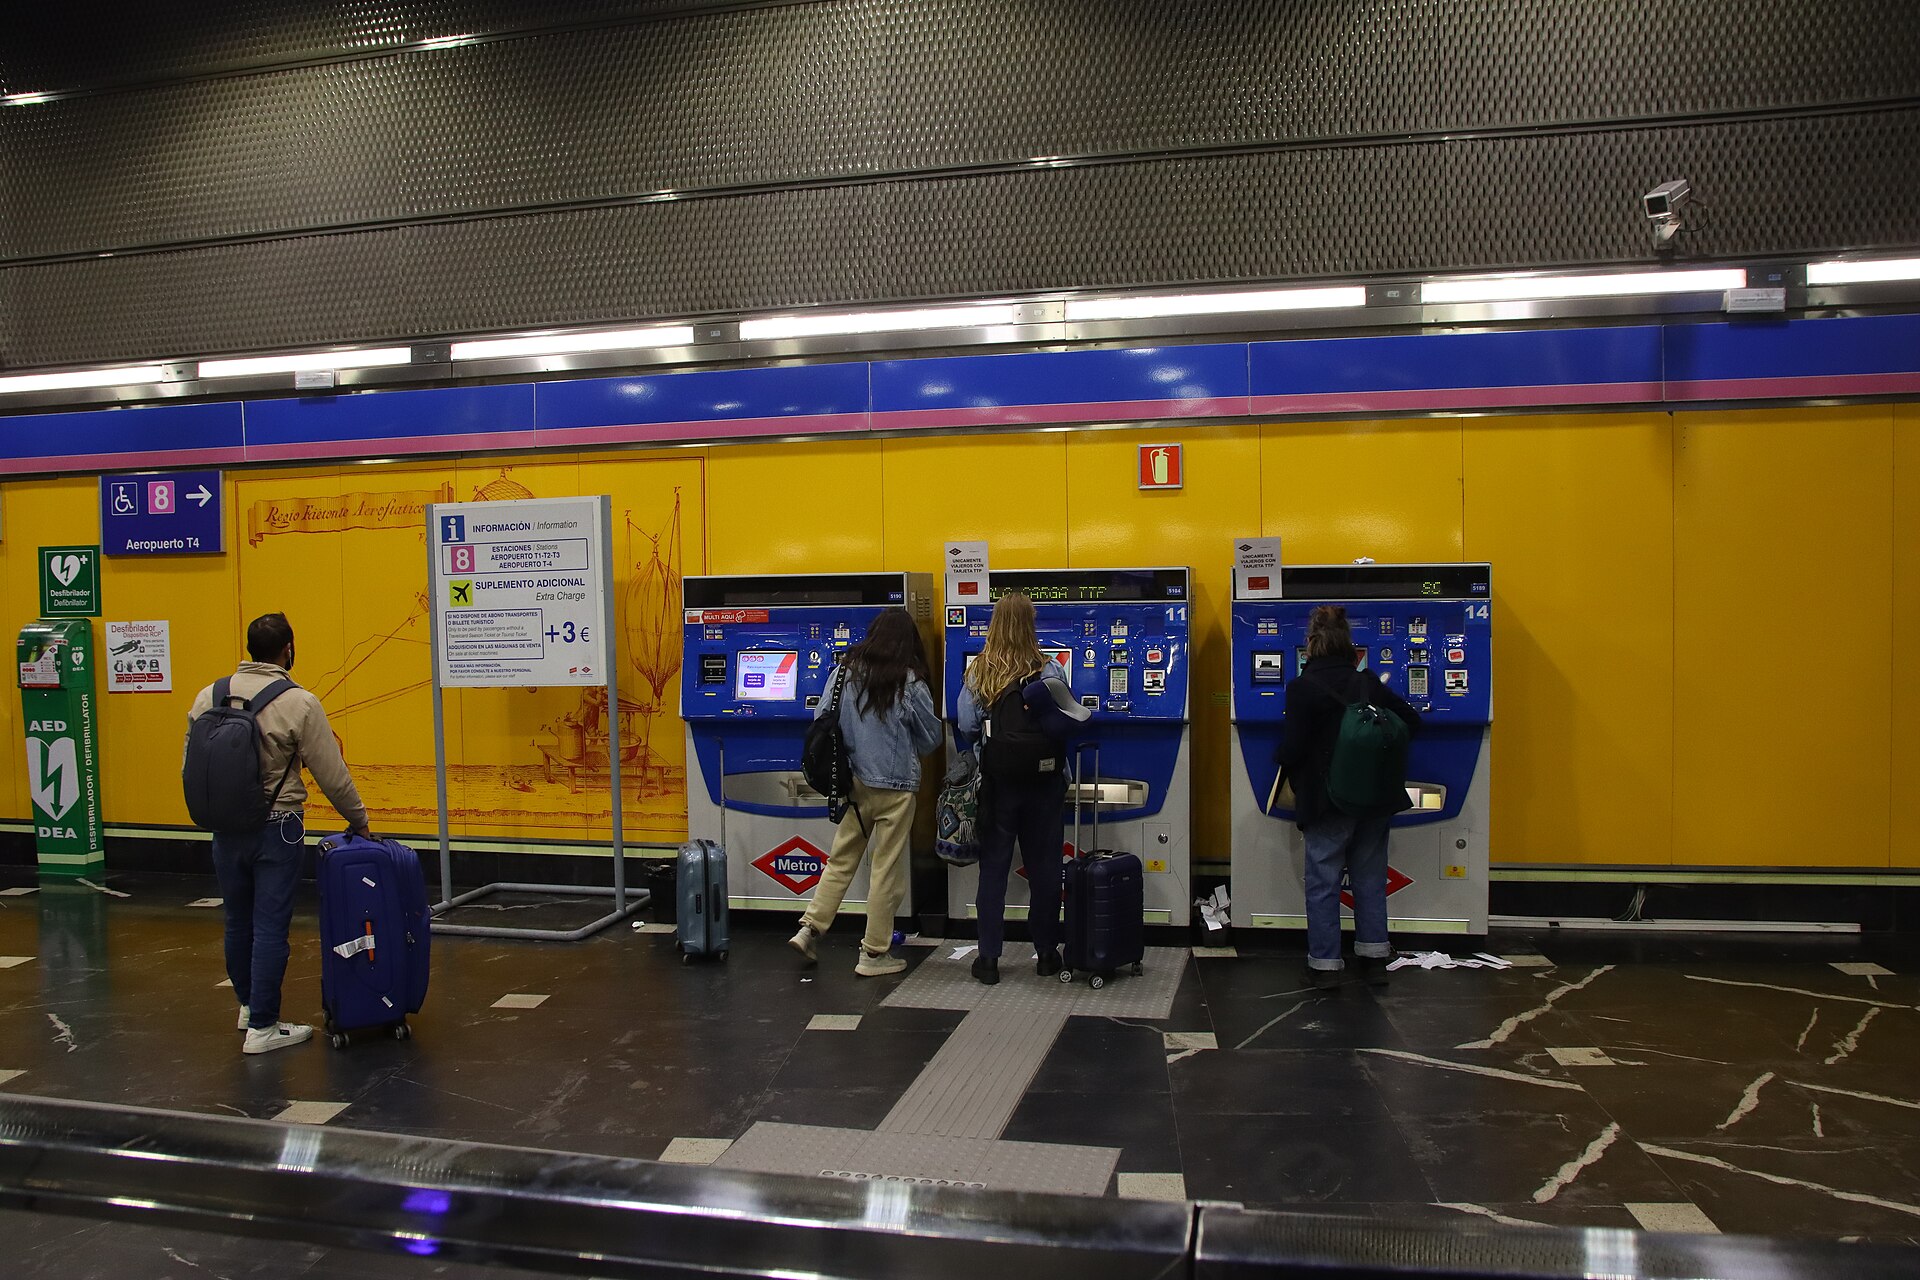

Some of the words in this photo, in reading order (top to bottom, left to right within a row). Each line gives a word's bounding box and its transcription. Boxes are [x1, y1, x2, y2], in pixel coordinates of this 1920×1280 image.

[154, 485, 169, 510] 8
[472, 521, 531, 533] INFORMACIÓN
[536, 520, 578, 530] Information
[126, 538, 184, 552] Aeropuerto
[186, 537, 200, 548] T4
[492, 544, 532, 552] ESTACIONES
[536, 543, 558, 551] Stations
[456, 548, 470, 570] 8
[490, 553, 533, 561] AEROPUERTO
[498, 561, 541, 569] AEROPUERTO
[543, 560, 552, 568] T-4
[475, 580, 534, 590] SUPLEMENTO
[536, 577, 585, 588] ADICIONAL
[50, 589, 91, 597] Desfibrilador
[535, 592, 554, 601] Extra
[556, 591, 586, 602] Charge
[1079, 586, 1107, 599] TTP
[54, 599, 88, 607] Defibrillator
[1166, 607, 1187, 621] 11
[1465, 604, 1489, 620] 14
[111, 624, 156, 633] Desfibrilador
[579, 627, 590, 642] €
[29, 720, 67, 732] AED
[81, 693, 93, 766] DEFIBRILLATOR
[86, 774, 97, 850] DESFIBRILADOR
[38, 827, 78, 839] DEA
[778, 858, 818, 872] Metro
